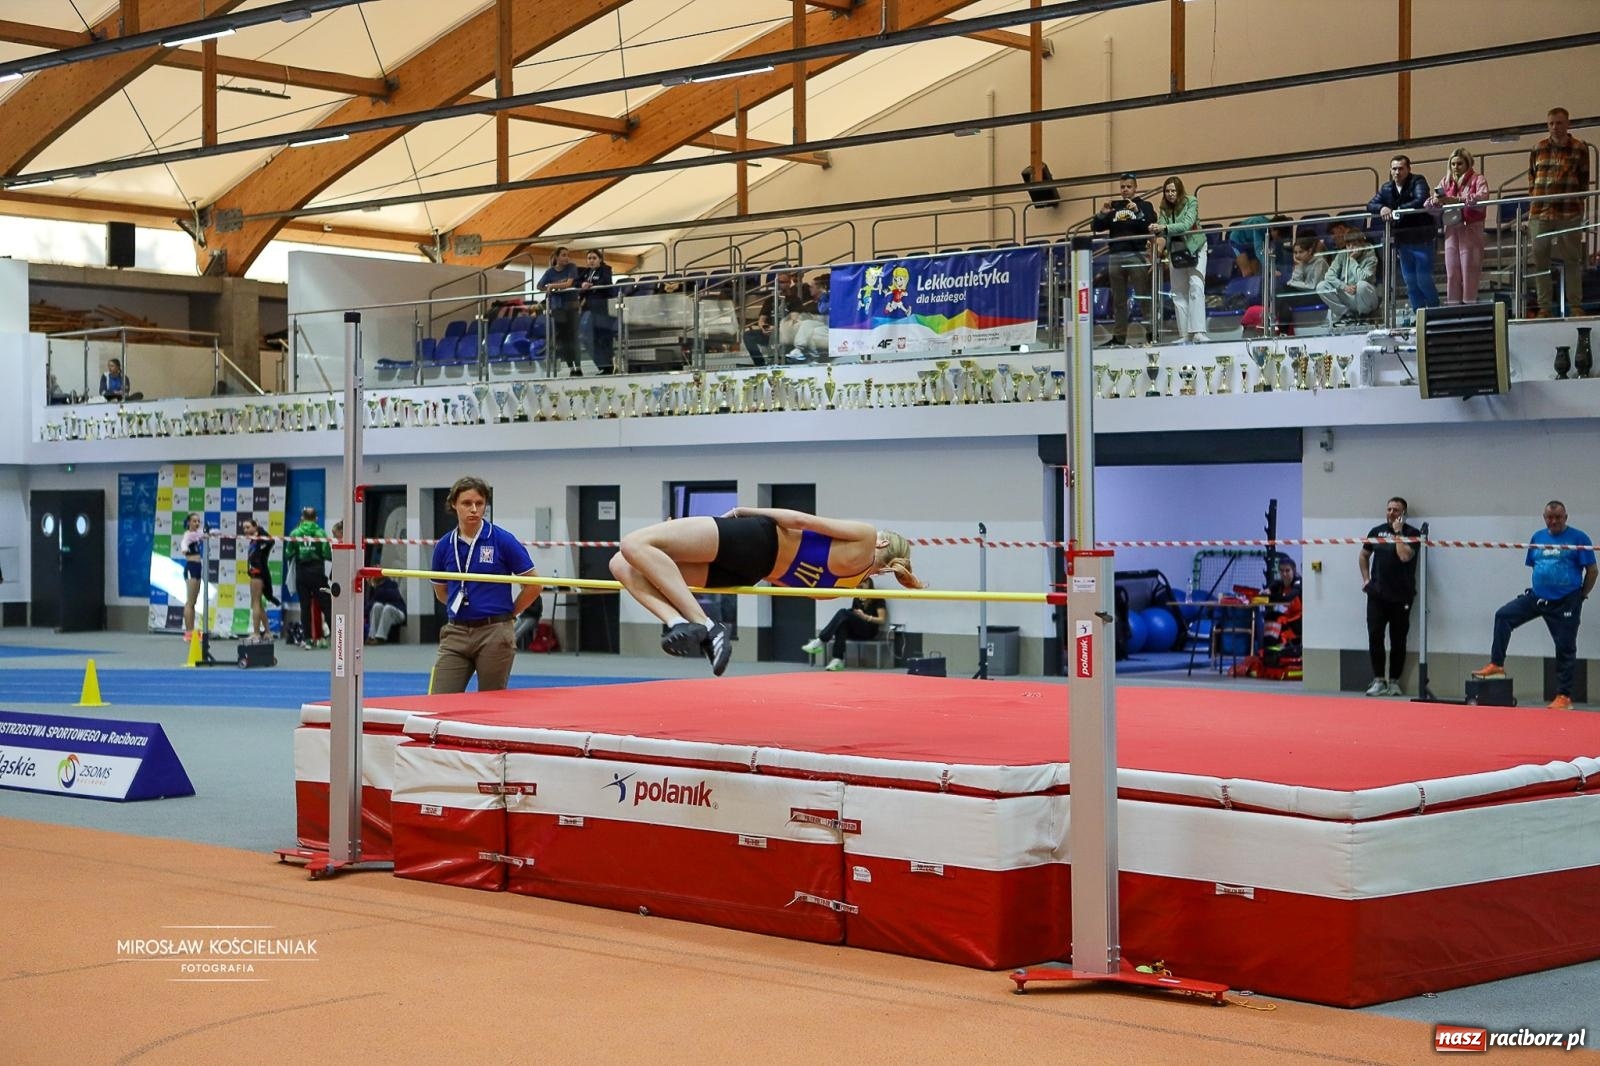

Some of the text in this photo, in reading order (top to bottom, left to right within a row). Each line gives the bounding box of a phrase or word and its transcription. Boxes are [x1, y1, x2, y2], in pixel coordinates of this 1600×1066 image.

[917, 268, 1010, 291] Lekkoatletyka
[916, 290, 967, 304] dla każdego!
[793, 561, 824, 588] 117
[1080, 639, 1090, 676] polanik
[46, 726, 101, 743] SPORTOWEGO
[100, 732, 108, 743] w
[107, 731, 149, 746] Raciborzu
[80, 765, 112, 779] ZSOMS
[634, 777, 713, 807] polanik
